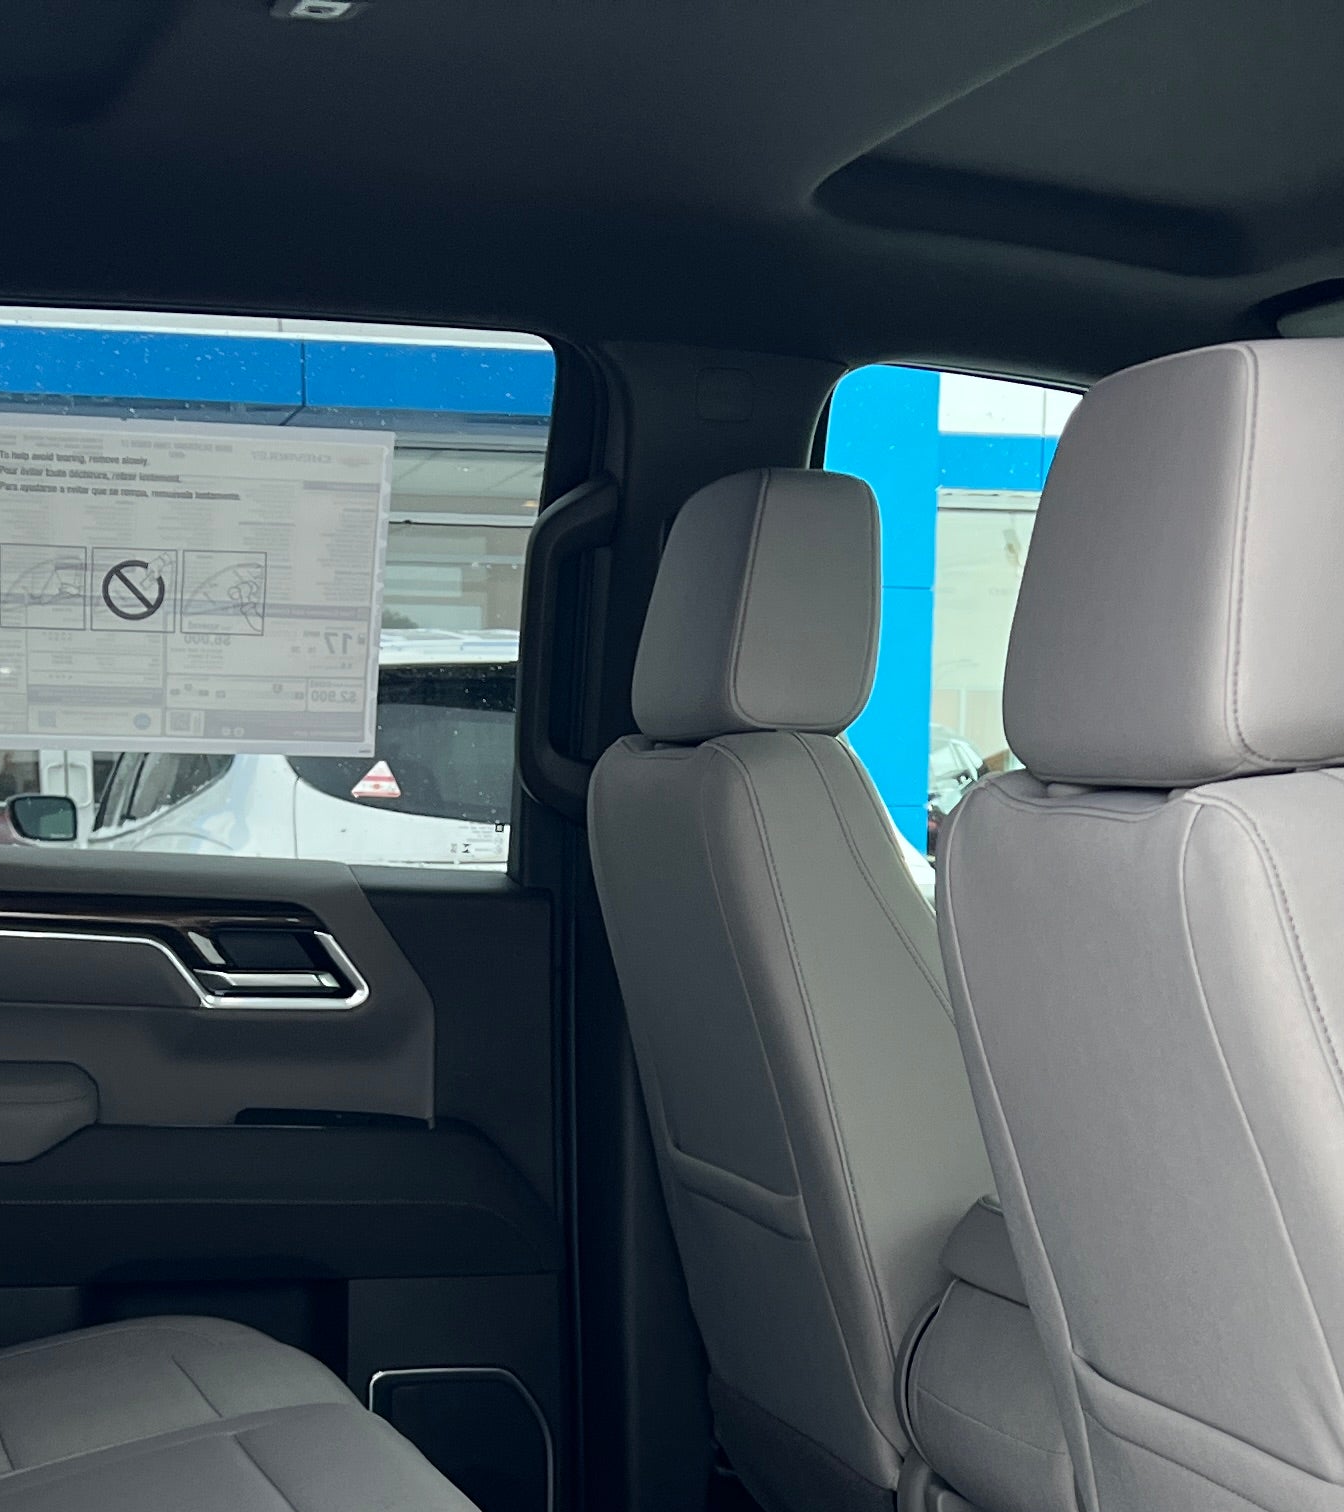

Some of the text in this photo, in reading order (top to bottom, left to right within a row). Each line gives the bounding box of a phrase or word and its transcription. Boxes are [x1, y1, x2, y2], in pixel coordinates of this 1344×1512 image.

[0, 449, 9, 459] To
[12, 451, 29, 461] help
[31, 452, 54, 461] avoid
